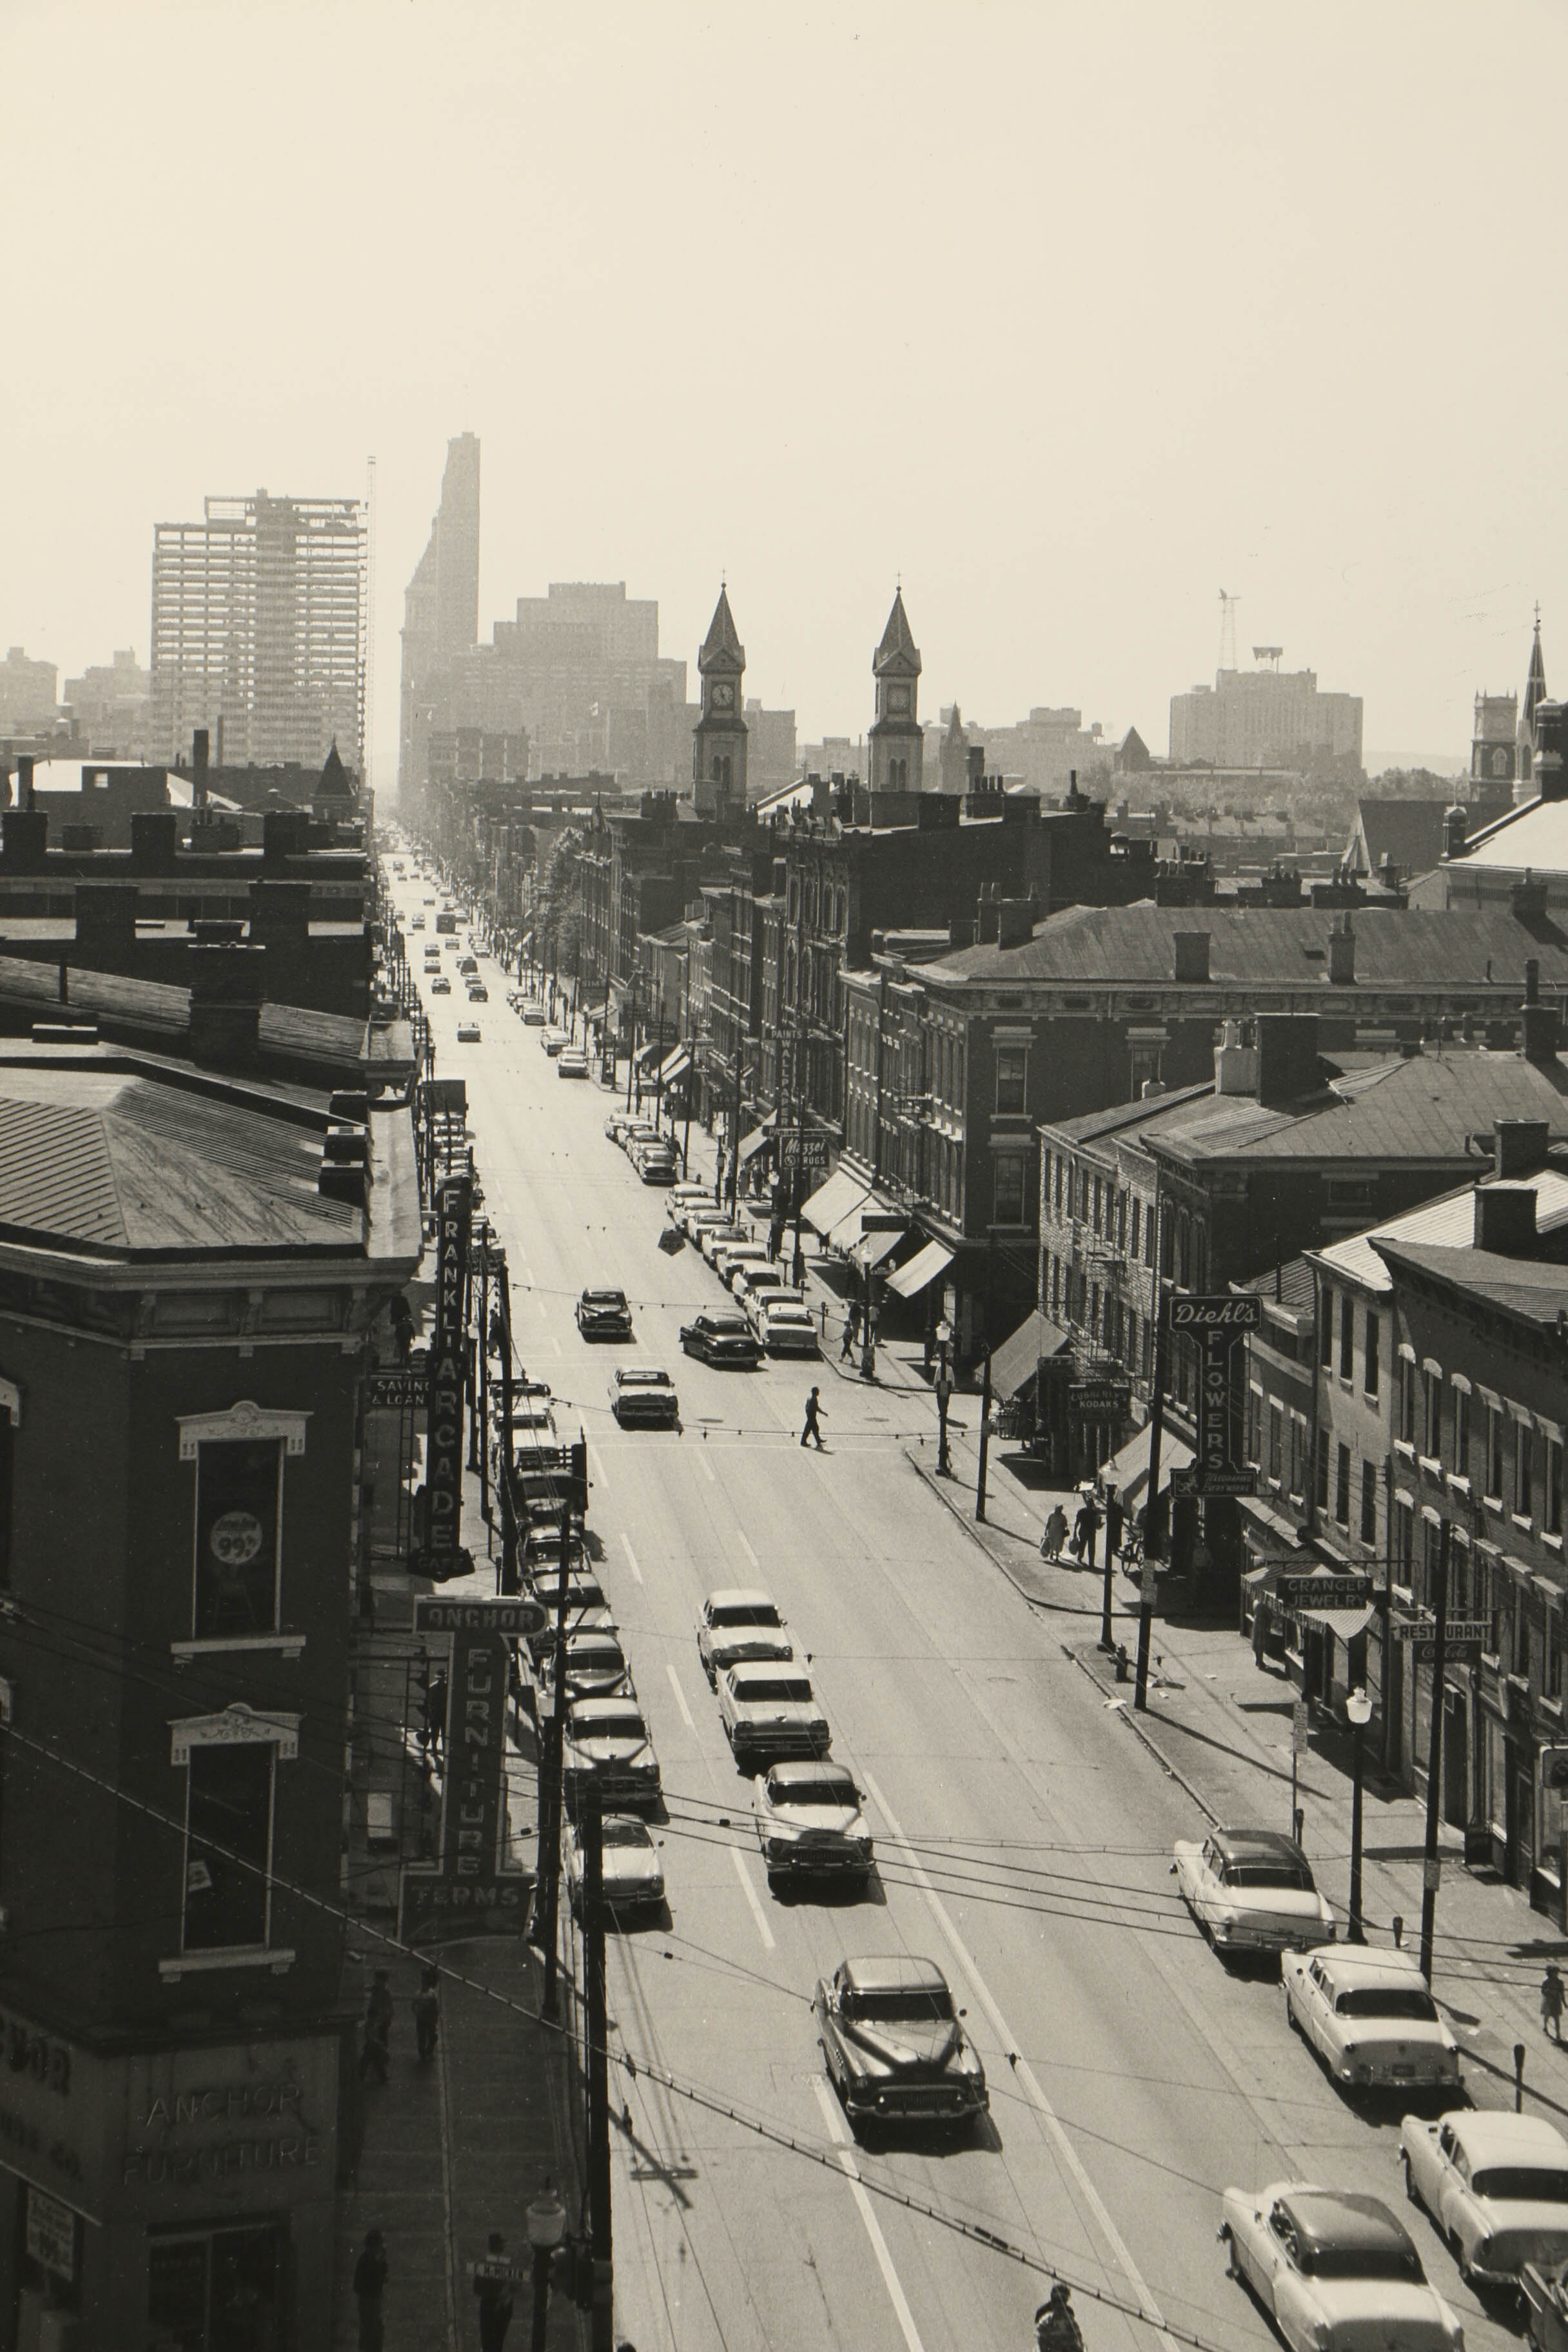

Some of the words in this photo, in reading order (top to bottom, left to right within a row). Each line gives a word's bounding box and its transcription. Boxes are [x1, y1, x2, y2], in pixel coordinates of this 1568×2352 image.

[771, 1030, 803, 1039] PAINTS
[780, 1040, 791, 1126] WALLPAPER
[797, 1156, 826, 1165] RUGS
[1175, 1302, 1255, 1324] Diehl's
[372, 1395, 382, 1404] &
[387, 1394, 424, 1405] LOAN
[1079, 1400, 1119, 1409] KODAKS
[1204, 1331, 1226, 1469] FLOWERS
[431, 1357, 458, 1549] ARCADE
[1288, 1580, 1366, 1591] GRANGER
[1289, 1594, 1366, 1607] JEWELRY
[429, 1607, 534, 1631] ANCHOR
[1400, 1625, 1491, 1639] RESTURANT
[456, 1649, 492, 1876] FURNITURE
[411, 1886, 519, 1906] TERMS
[145, 2083, 301, 2129] ANCHOR
[123, 2135, 321, 2186] FURNITURE
